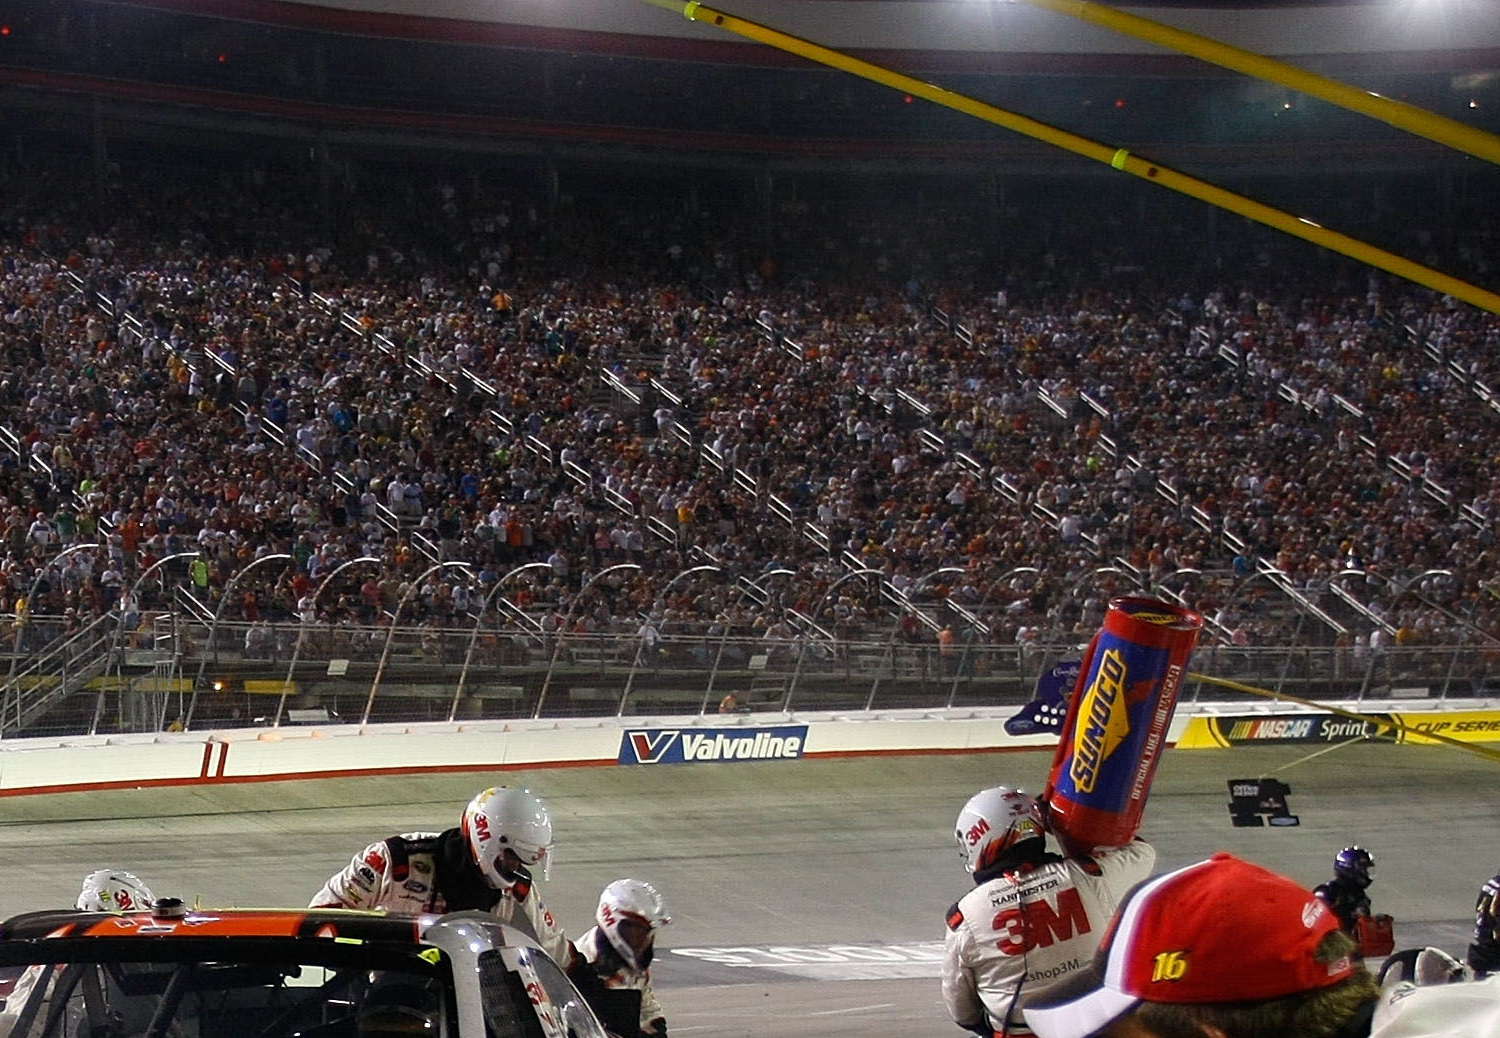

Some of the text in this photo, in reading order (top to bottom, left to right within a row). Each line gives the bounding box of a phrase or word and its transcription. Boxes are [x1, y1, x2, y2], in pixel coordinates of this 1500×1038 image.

[1073, 656, 1123, 787] SUNOCO
[1254, 719, 1313, 738] NASCAR
[1319, 719, 1368, 741] Sprint
[1415, 722, 1451, 733] CUP
[682, 733, 800, 760] Valvoline
[474, 812, 492, 843] 3M
[965, 818, 991, 847] 3M
[602, 903, 615, 928] 3M
[992, 887, 1091, 956] 3M
[1152, 951, 1187, 983] 16
